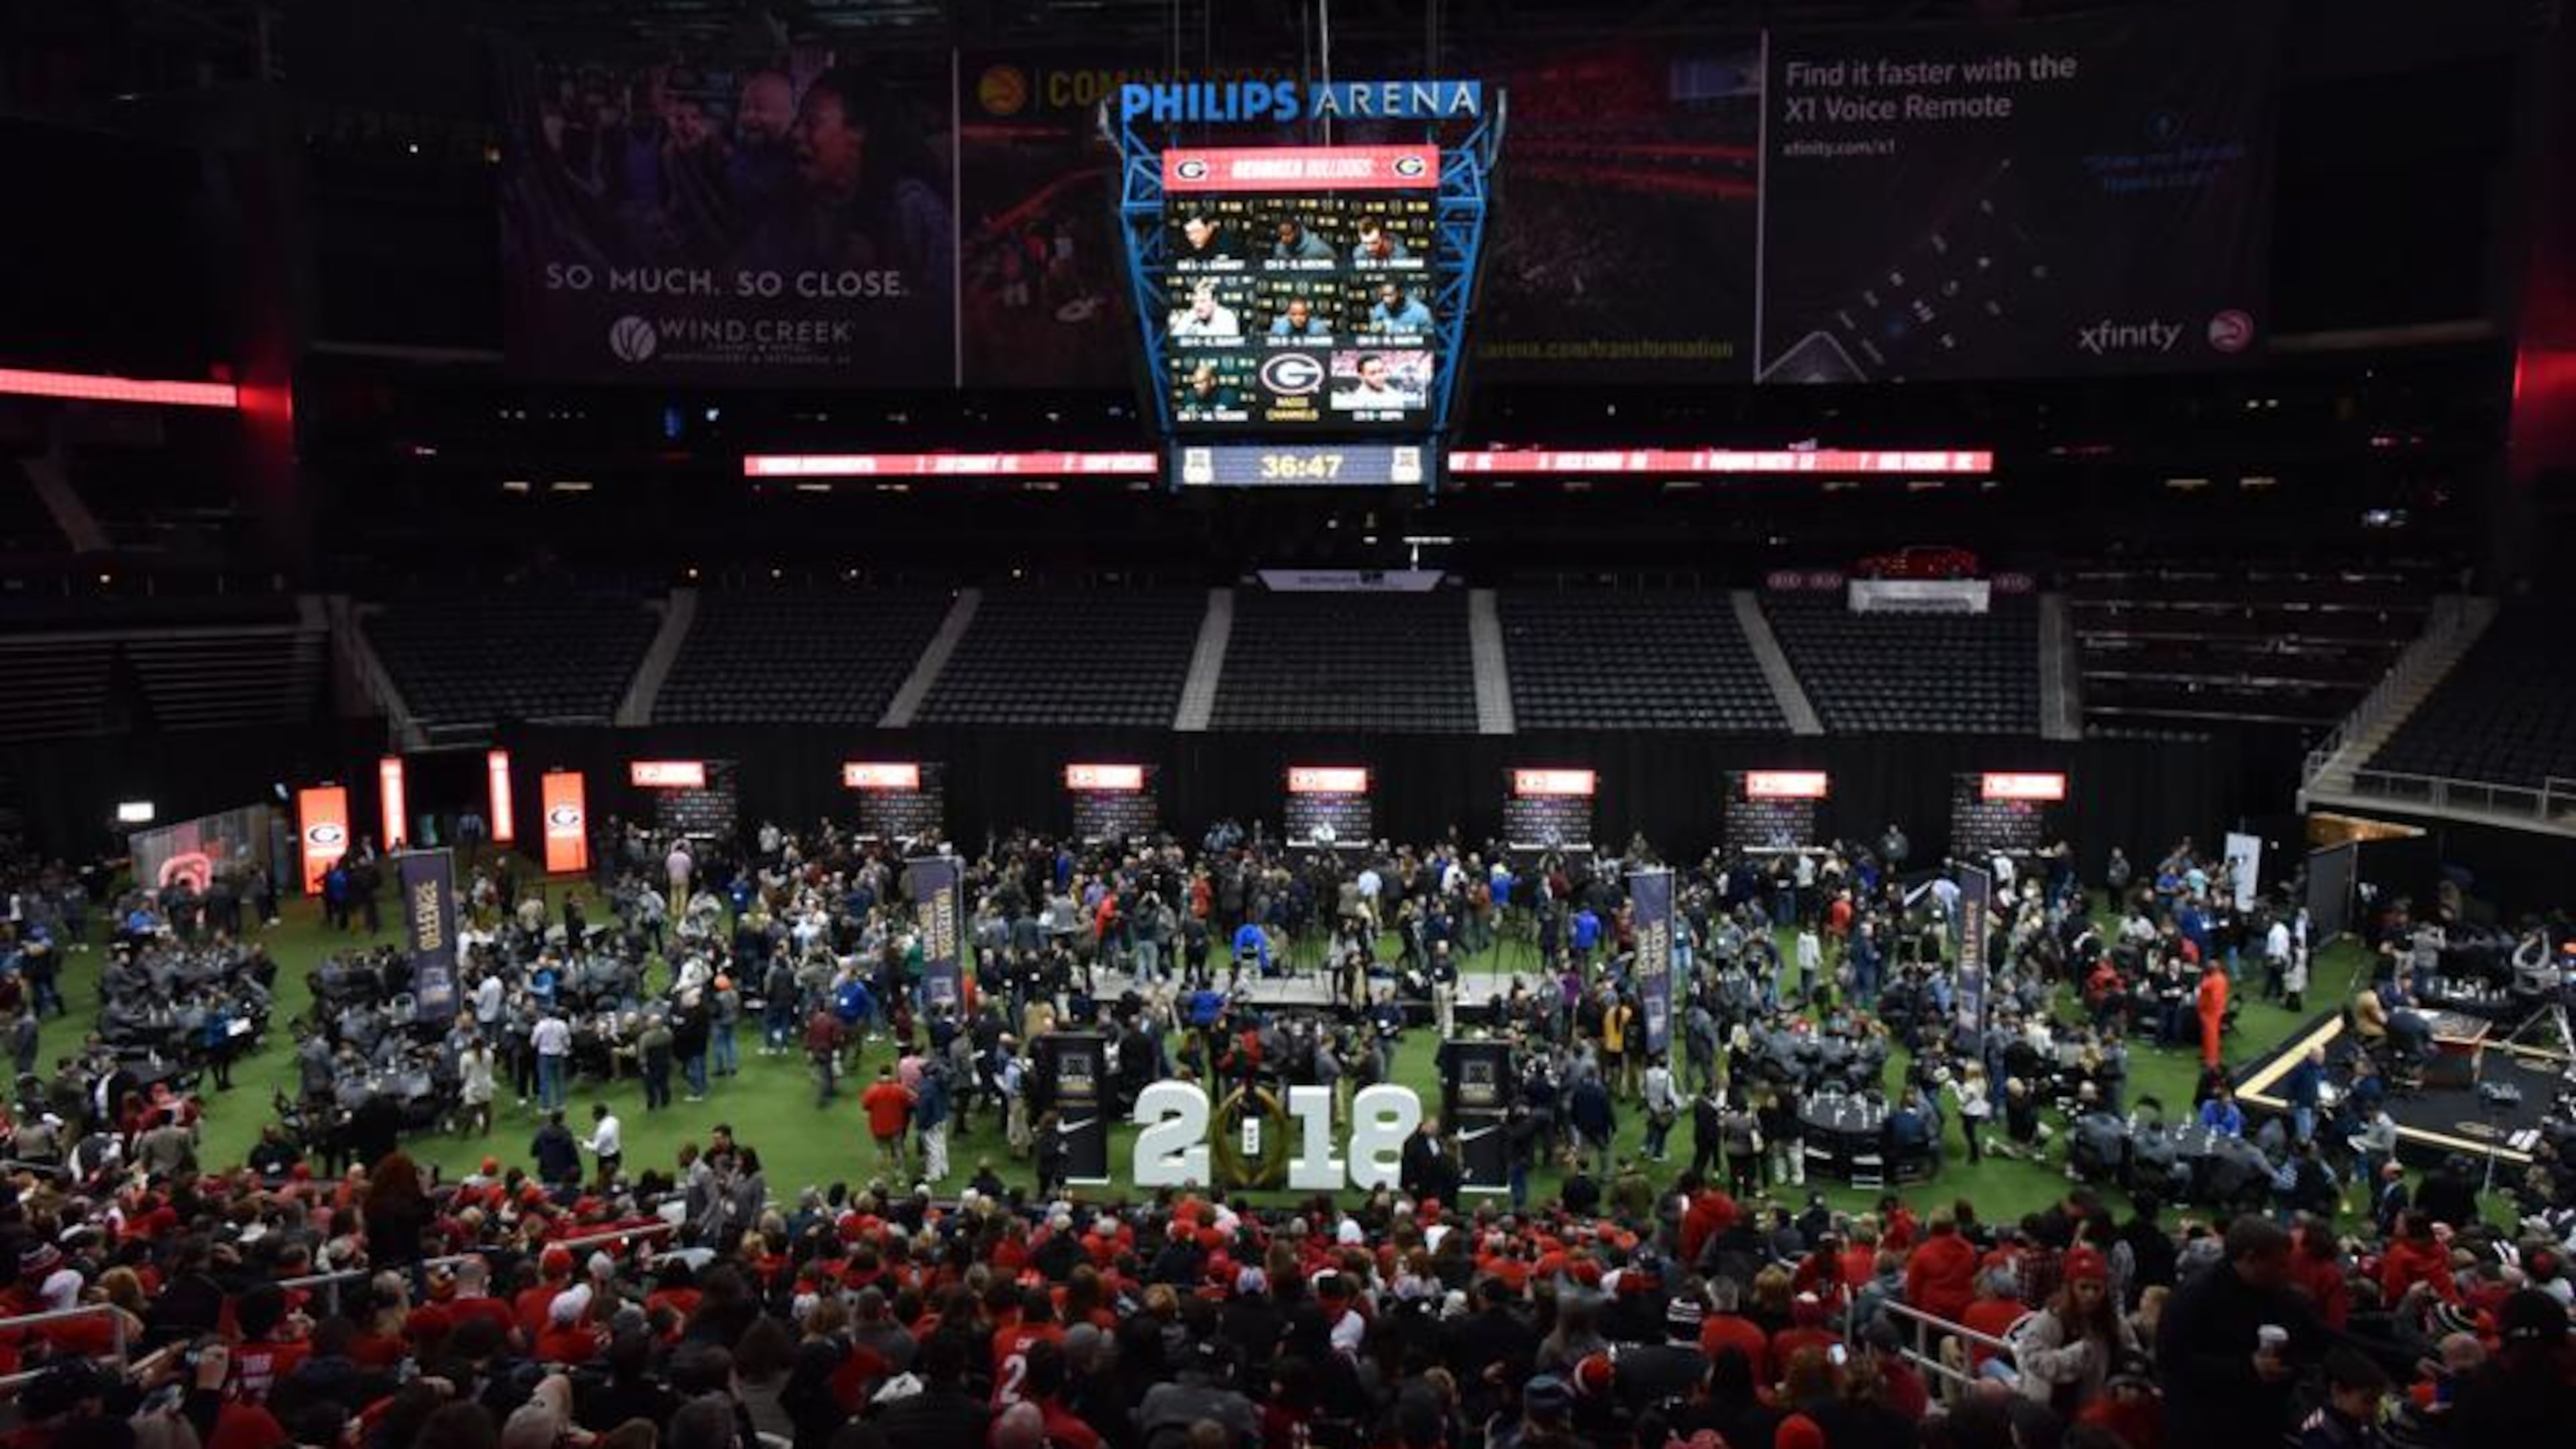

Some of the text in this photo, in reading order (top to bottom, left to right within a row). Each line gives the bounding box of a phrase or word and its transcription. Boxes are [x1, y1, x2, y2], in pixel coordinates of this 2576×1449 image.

[1785, 53, 2079, 87] Find it faster with the
[1121, 81, 1479, 123] PHILIPS ARENA
[1784, 93, 2013, 122] X1 Voice Remote
[545, 262, 910, 298] SO MUCH. SO CLOSE.
[659, 315, 855, 344] WIND CREEK
[2078, 317, 2186, 356] xfinity
[1260, 454, 1343, 478] 36:47
